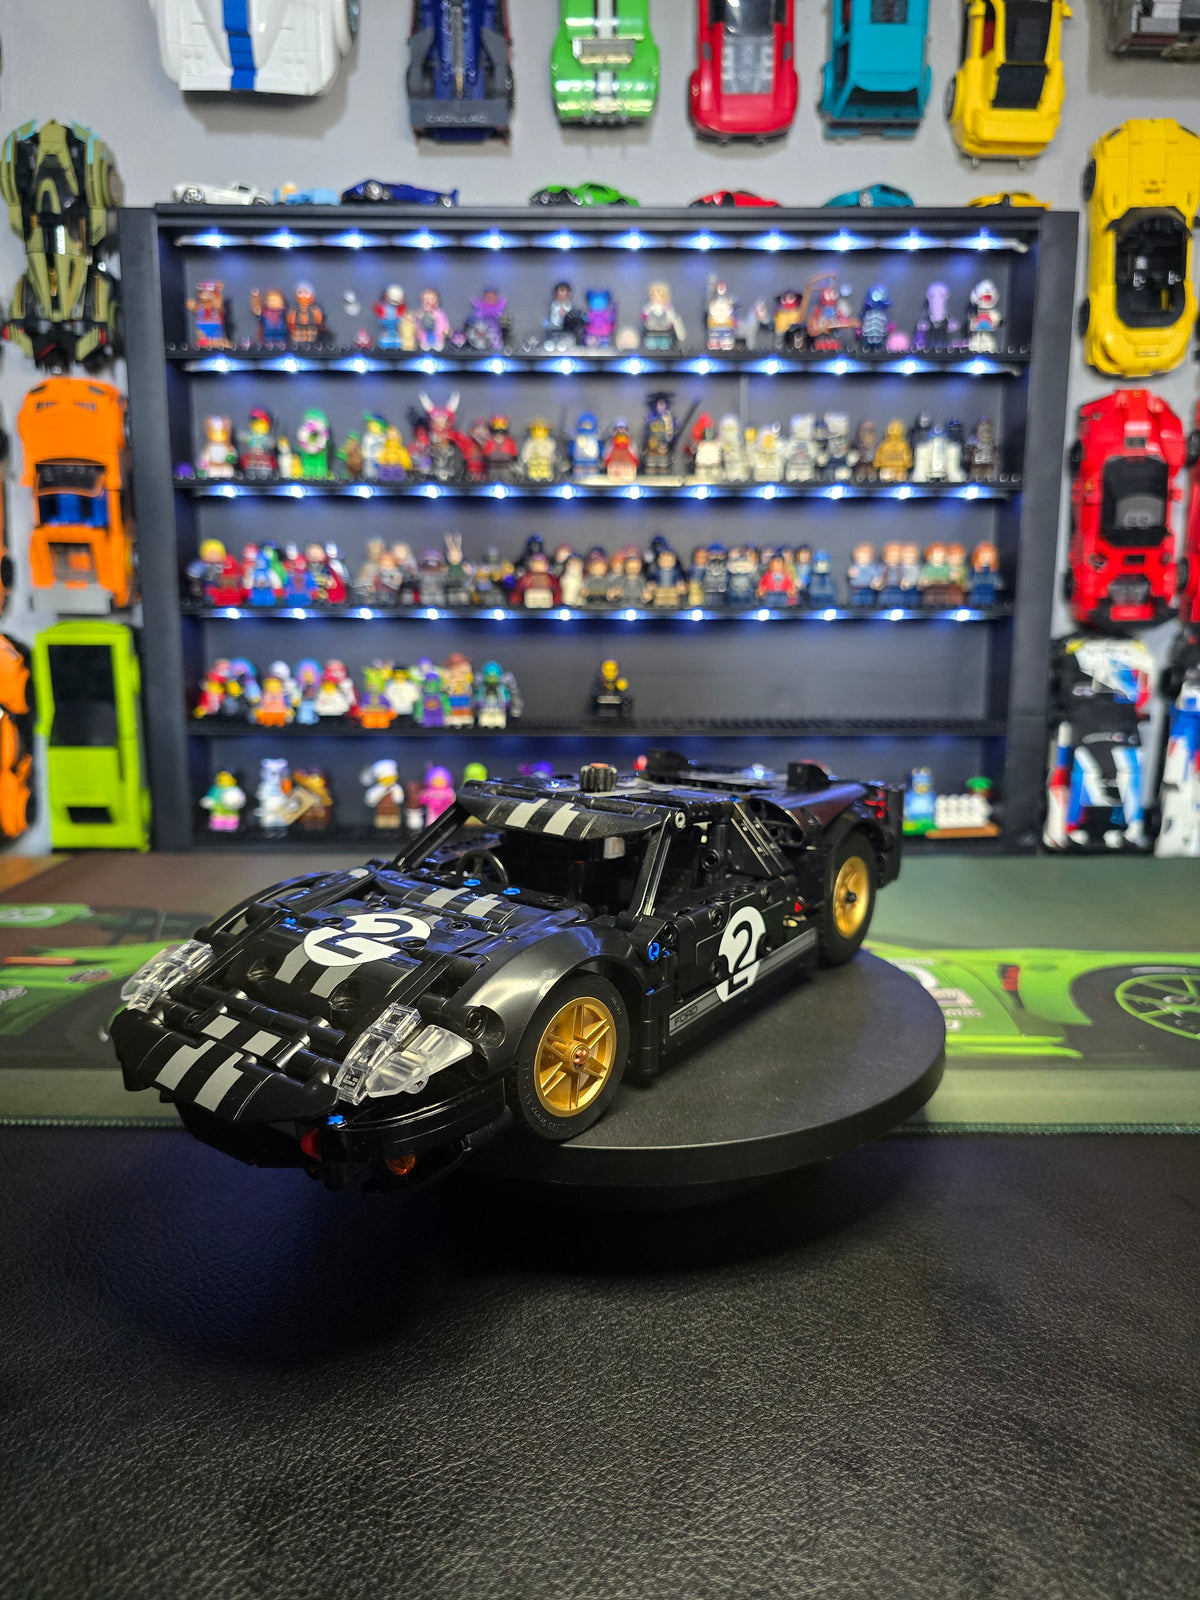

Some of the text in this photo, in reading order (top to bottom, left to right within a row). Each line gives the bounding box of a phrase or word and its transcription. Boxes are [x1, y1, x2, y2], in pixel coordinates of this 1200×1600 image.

[313, 917, 414, 960] 2
[727, 920, 753, 996] 2
[674, 1005, 698, 1027] FORD
